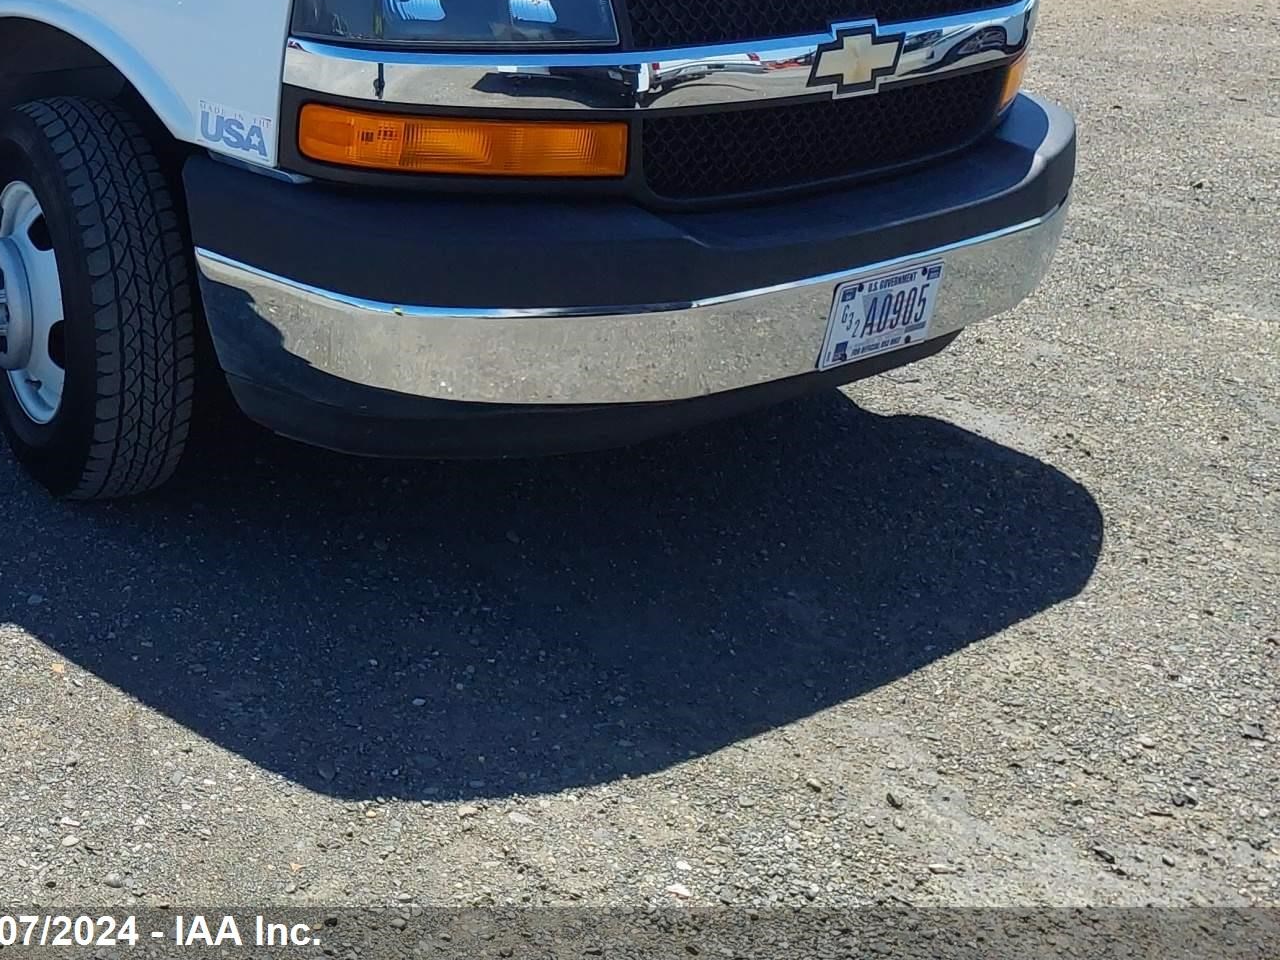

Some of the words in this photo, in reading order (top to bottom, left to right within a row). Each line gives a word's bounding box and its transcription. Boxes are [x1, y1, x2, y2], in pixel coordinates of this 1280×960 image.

[200, 110, 268, 157] USA
[879, 271, 918, 290] GOVERNMENT
[860, 283, 930, 338] A0905
